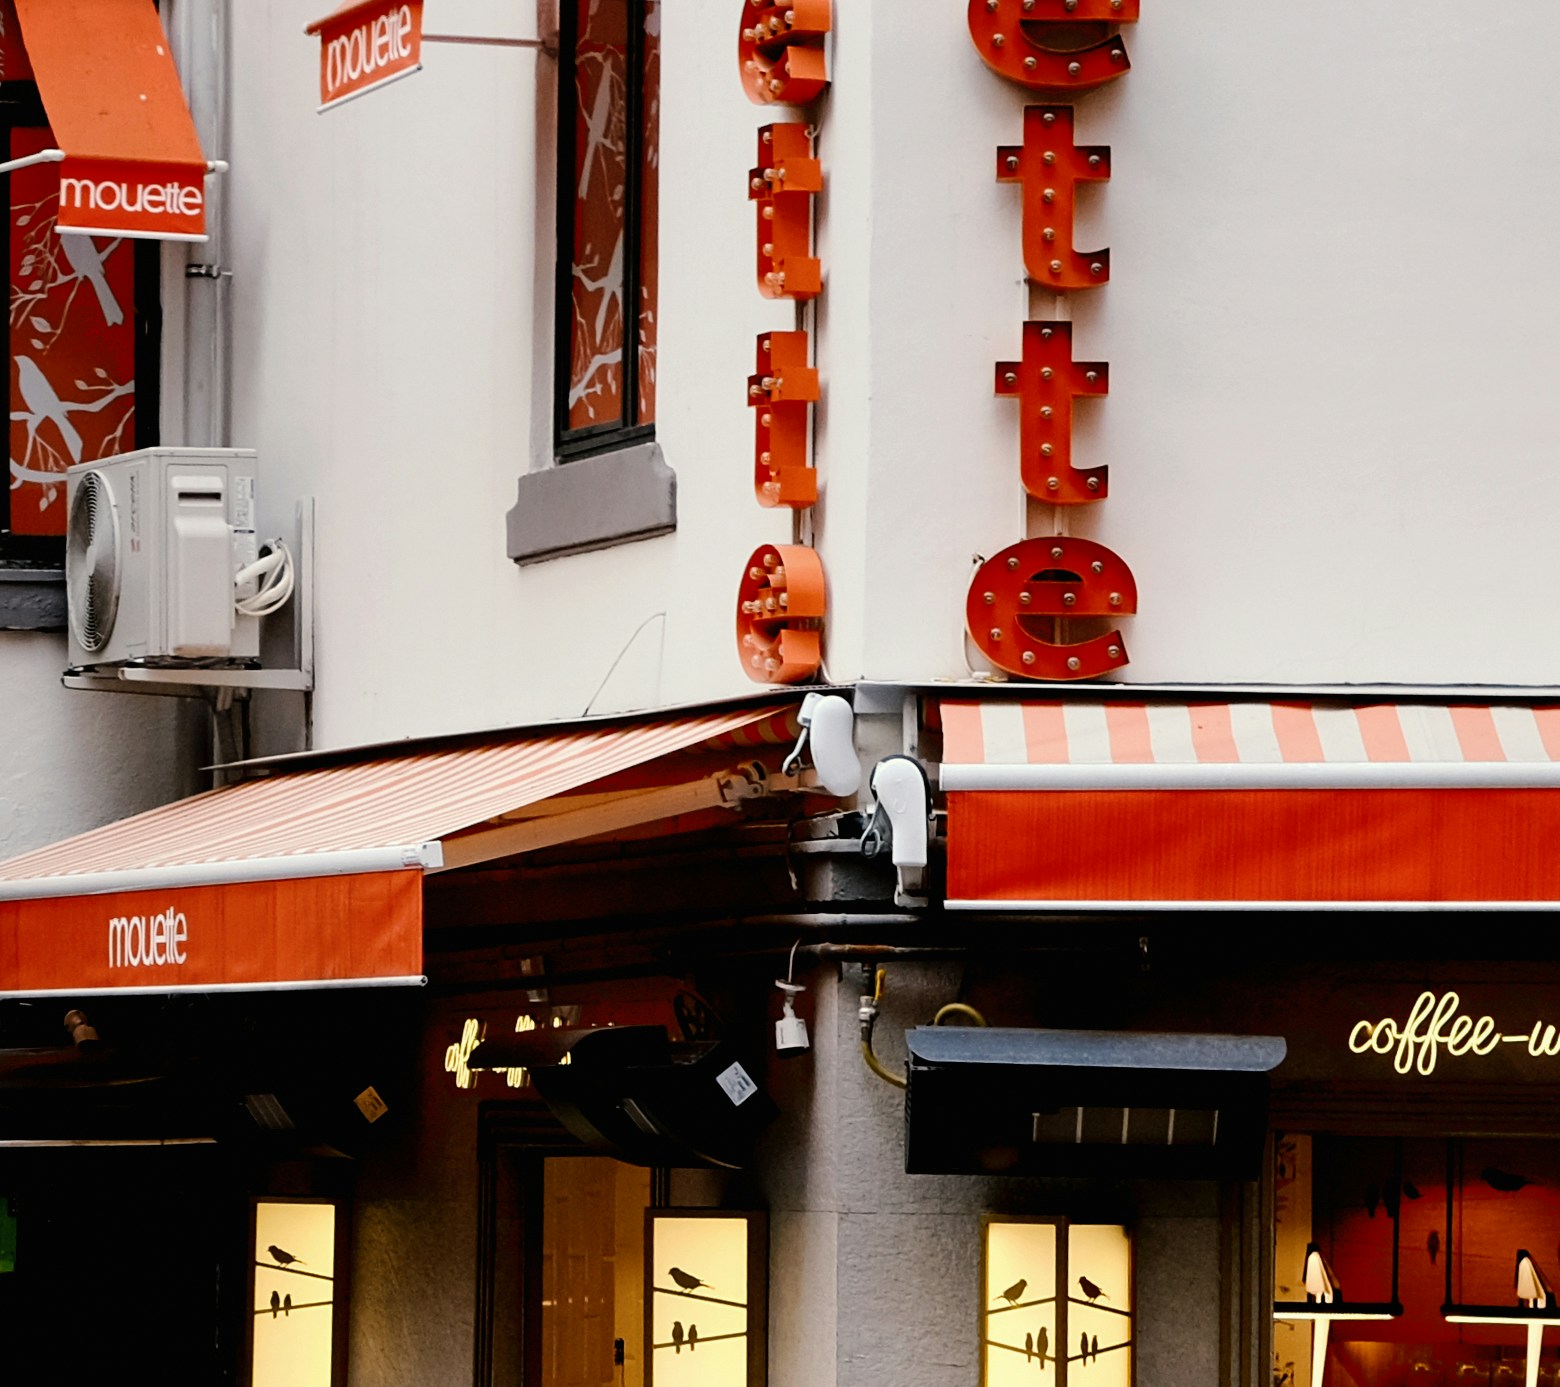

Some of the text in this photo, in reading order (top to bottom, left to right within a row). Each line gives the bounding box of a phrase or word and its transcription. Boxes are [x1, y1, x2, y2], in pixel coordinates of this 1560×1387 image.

[326, 3, 412, 93] mouette
[60, 177, 203, 217] mouette
[109, 906, 188, 969] mouette
